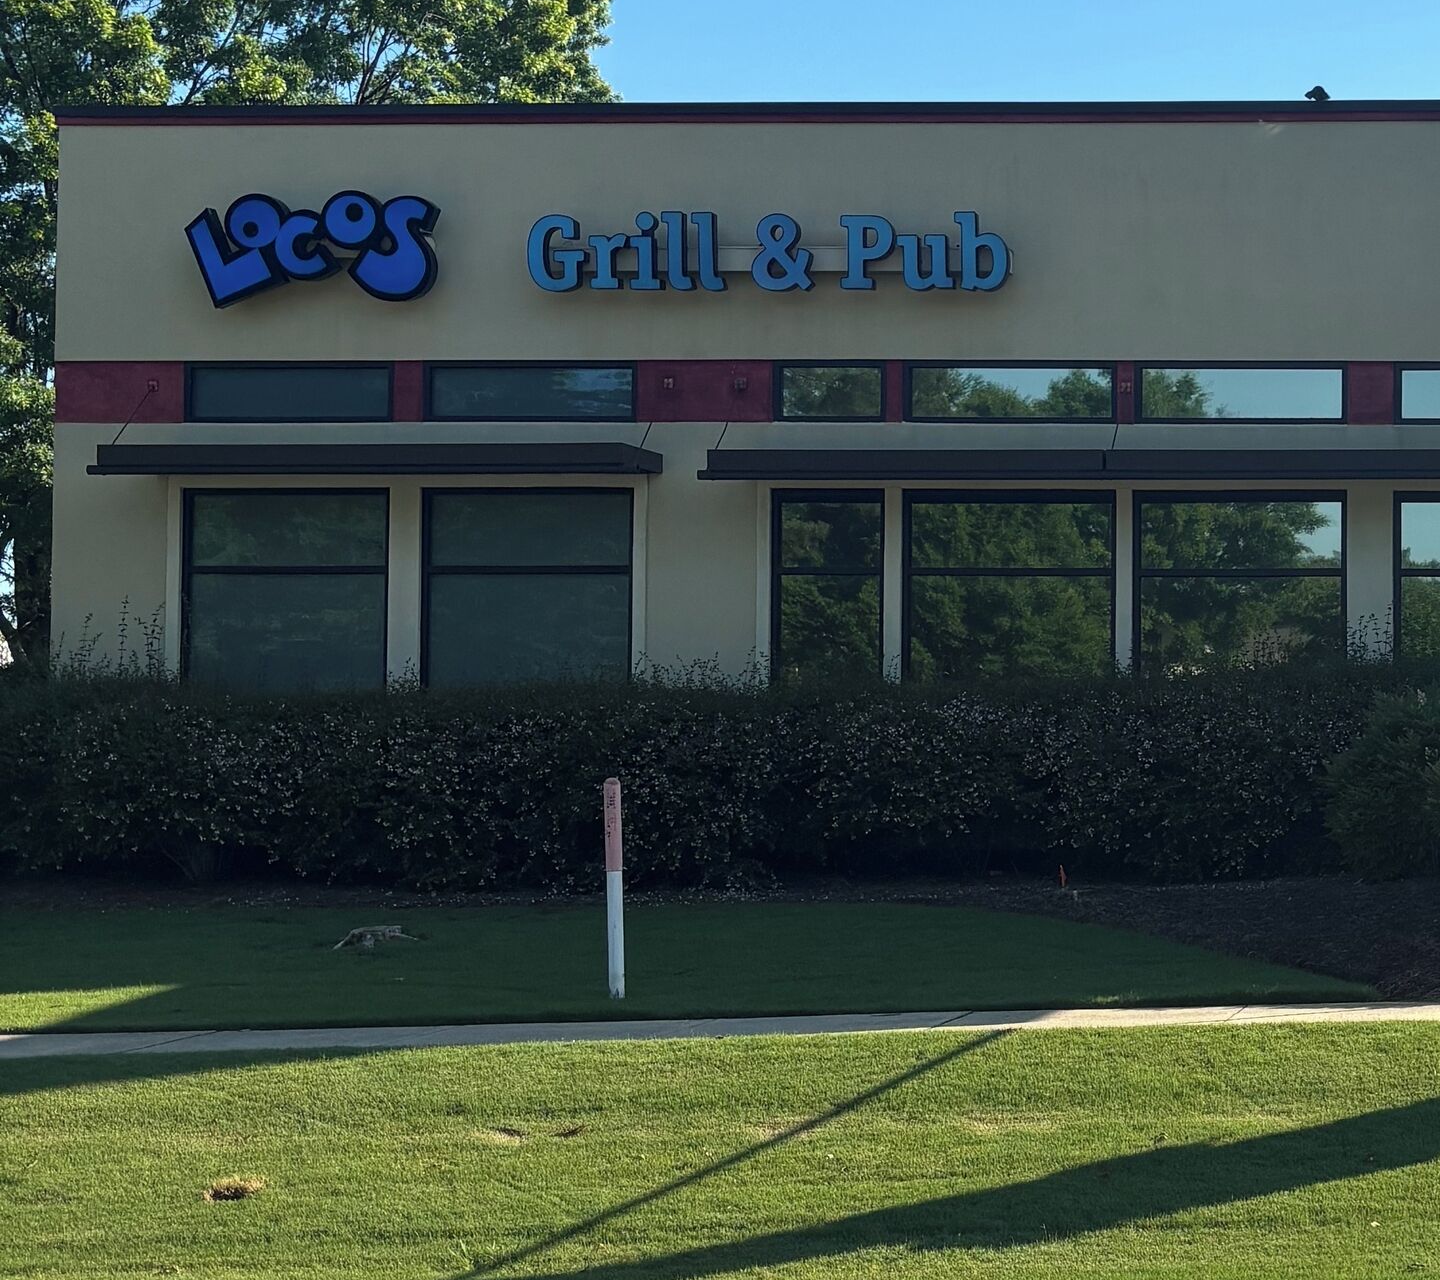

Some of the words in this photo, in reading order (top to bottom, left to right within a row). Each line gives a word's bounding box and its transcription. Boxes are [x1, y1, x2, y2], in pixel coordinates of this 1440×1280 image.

[527, 211, 729, 292] Grill
[751, 213, 814, 291] &
[840, 211, 1010, 292] Pub
